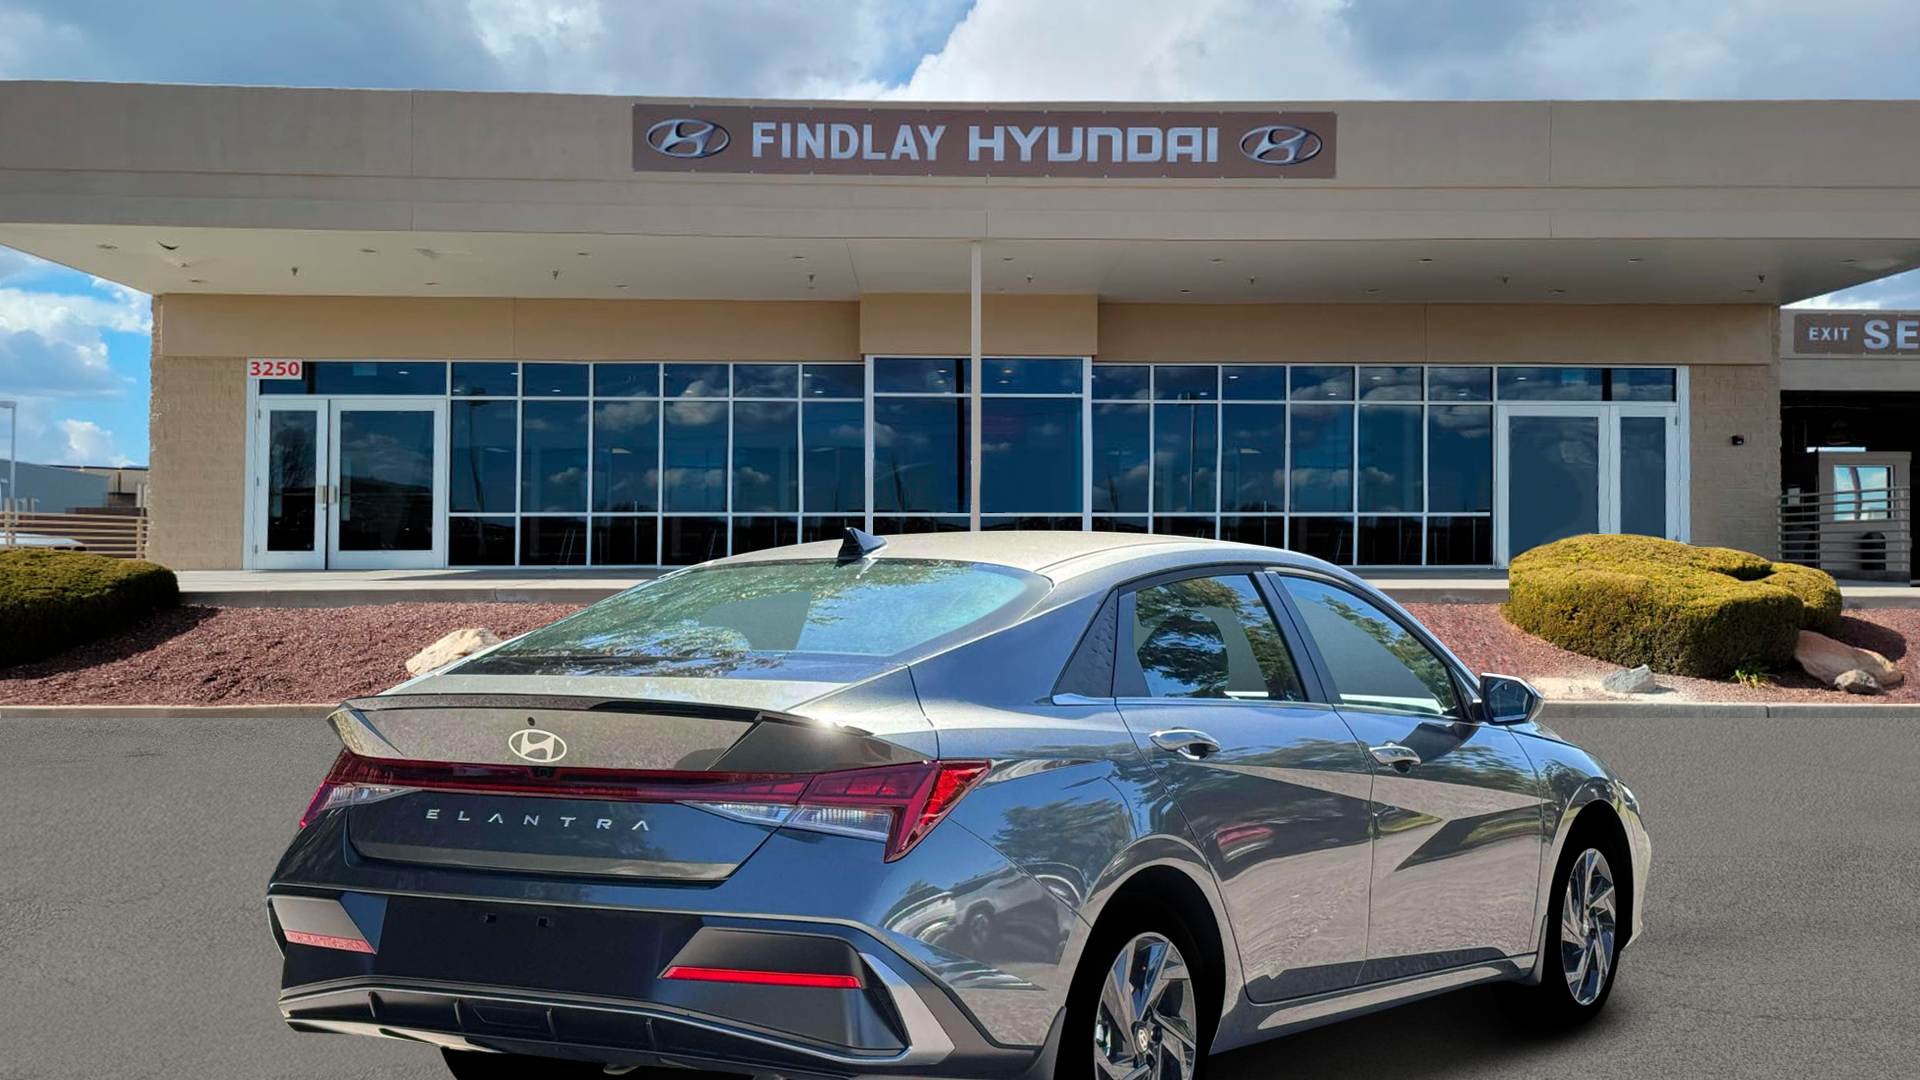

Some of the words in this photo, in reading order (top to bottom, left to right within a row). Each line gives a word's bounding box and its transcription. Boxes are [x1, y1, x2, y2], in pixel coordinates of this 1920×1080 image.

[752, 122, 946, 161] FINDLAY
[968, 125, 1219, 163] HYUNDAI
[1808, 326, 1850, 341] EXIT
[1863, 319, 1920, 349] SE
[250, 361, 300, 376] 3250
[426, 808, 650, 831] ELANTRA
